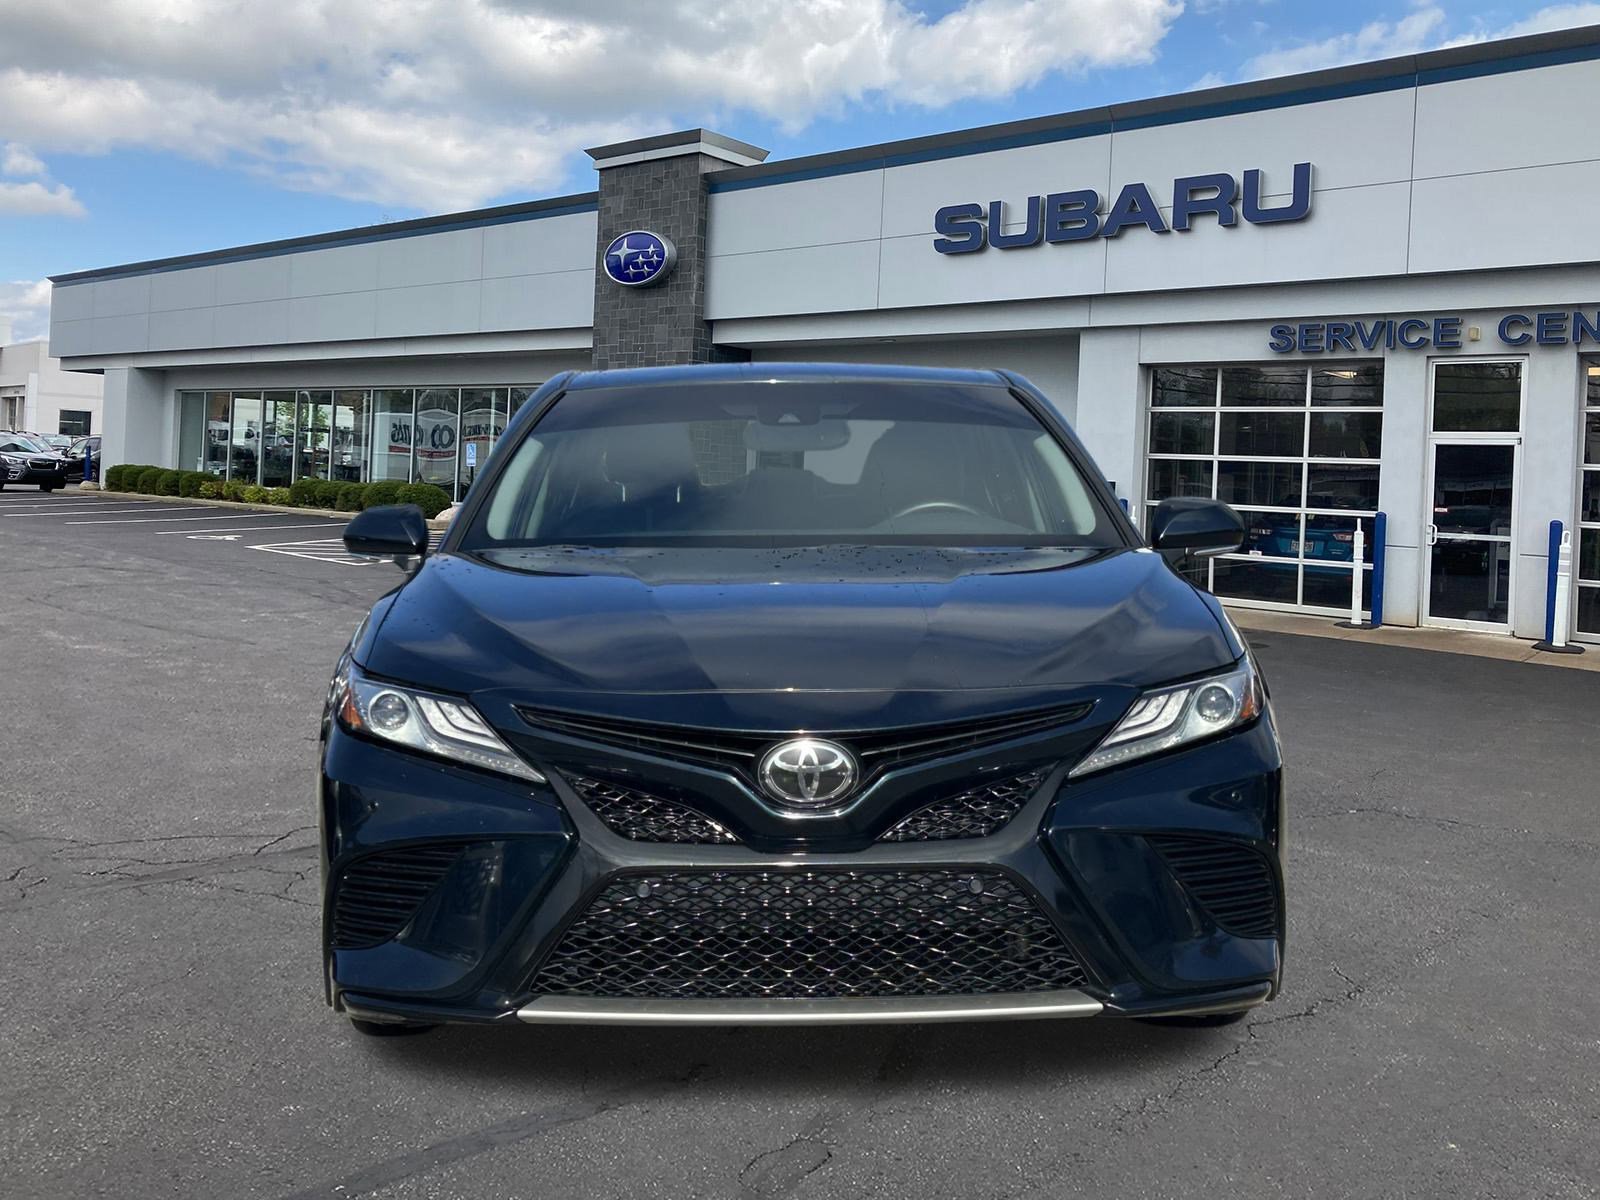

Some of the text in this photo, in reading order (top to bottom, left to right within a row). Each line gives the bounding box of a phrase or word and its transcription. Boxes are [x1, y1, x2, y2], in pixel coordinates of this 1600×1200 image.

[933, 161, 1314, 255] SUBARU
[1268, 310, 1600, 354] SERVICE CEN
